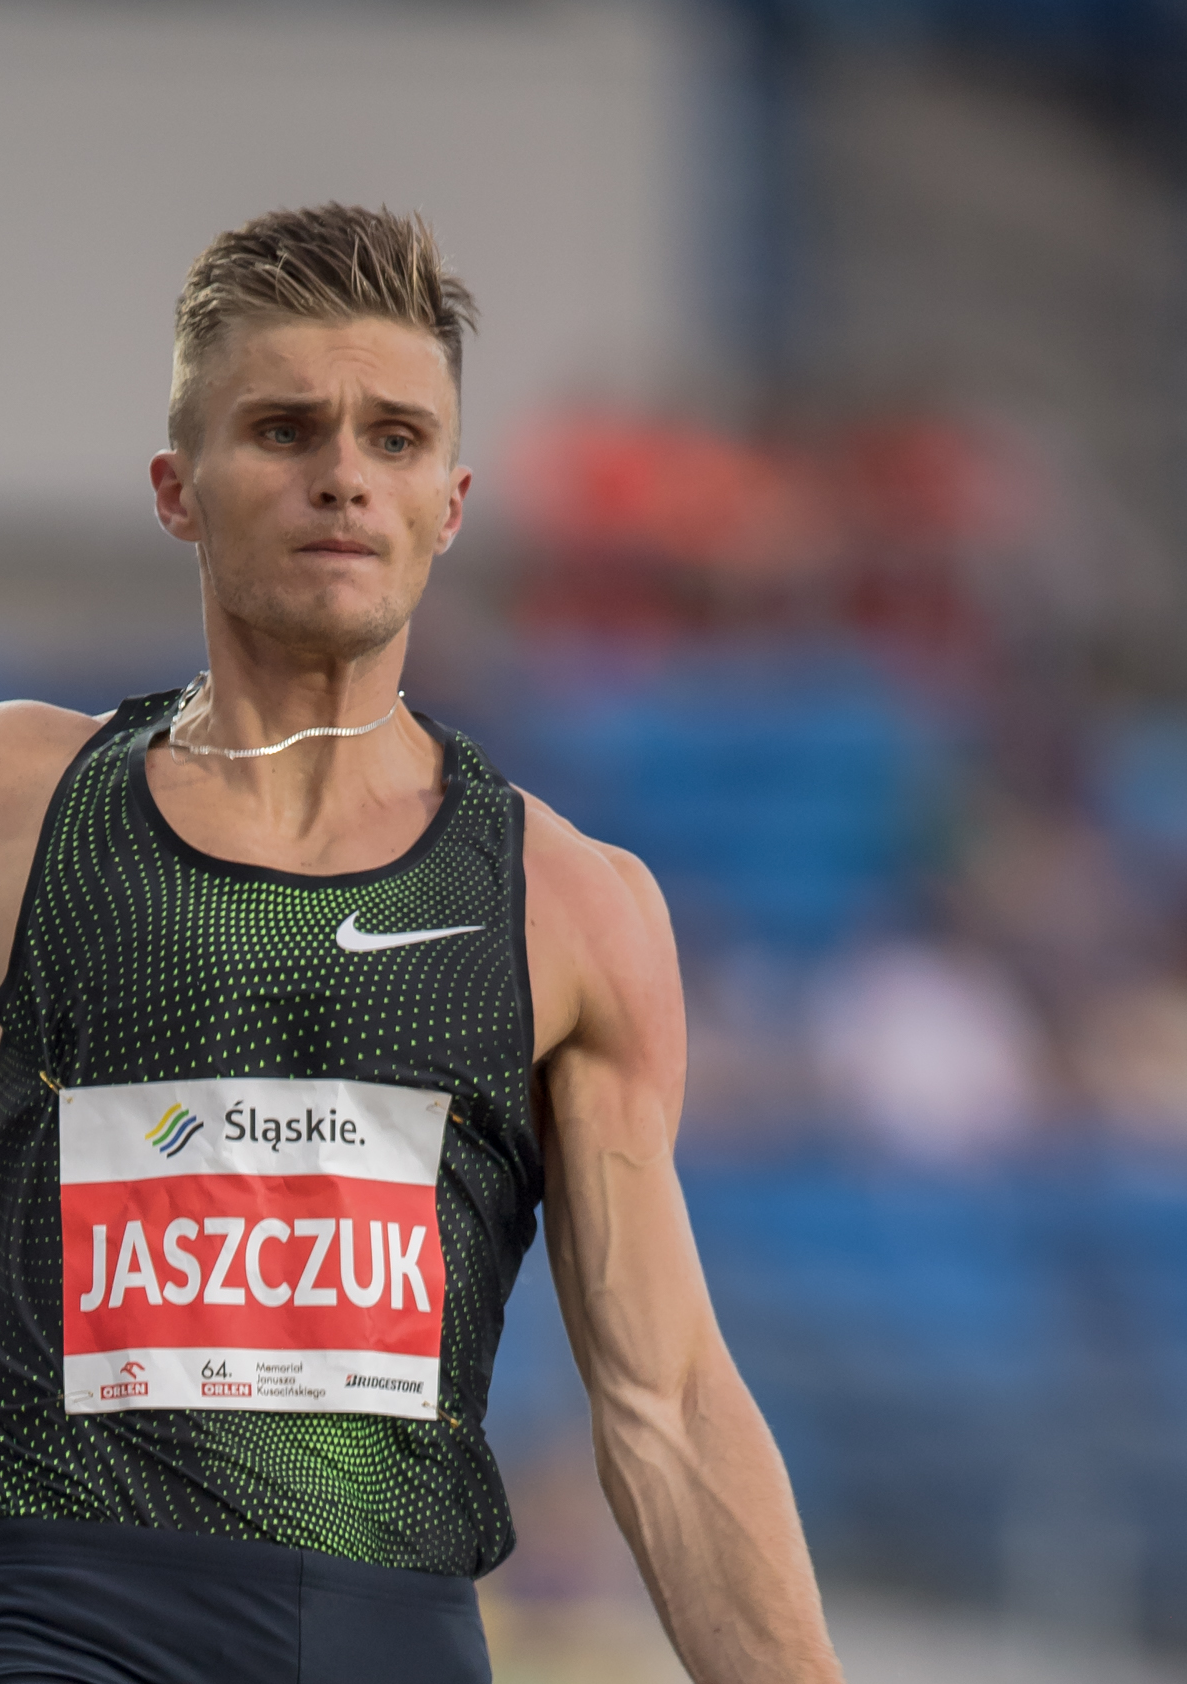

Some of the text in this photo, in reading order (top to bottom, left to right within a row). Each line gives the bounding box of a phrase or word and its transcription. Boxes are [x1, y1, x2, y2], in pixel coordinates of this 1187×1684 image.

[224, 1100, 366, 1152] Śląskie.
[79, 1216, 431, 1313] JASZCZUK
[201, 1359, 232, 1379] 64.
[203, 1383, 250, 1396] ORLEN
[257, 1374, 296, 1385] Janusza
[345, 1373, 424, 1394] BRIDGESTONE
[103, 1383, 145, 1398] ORLEN
